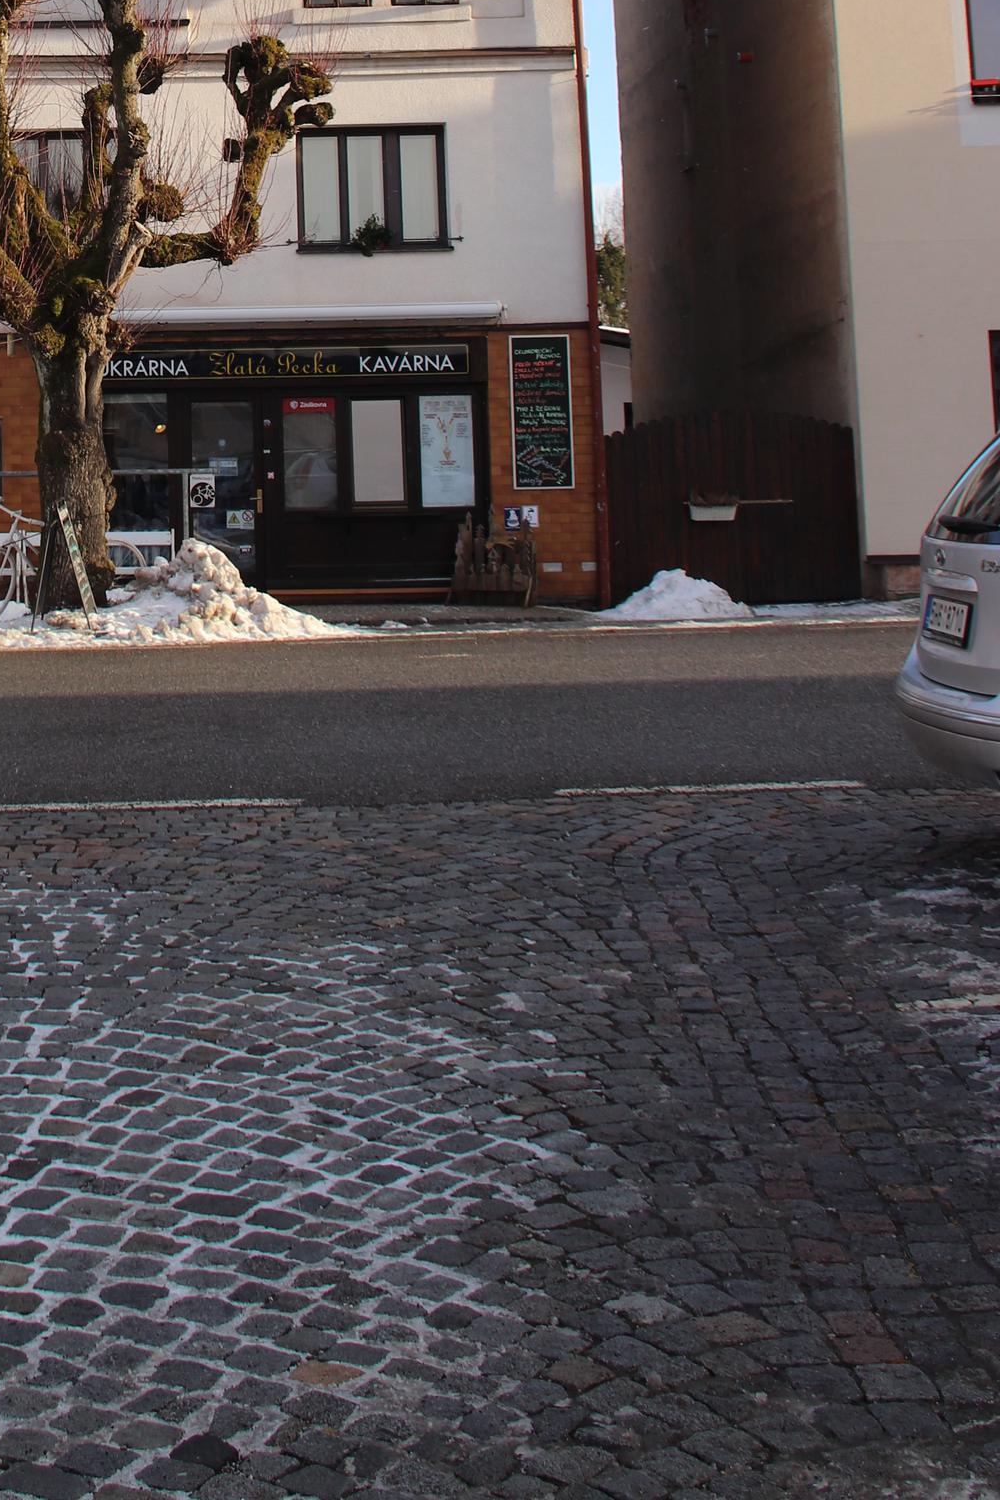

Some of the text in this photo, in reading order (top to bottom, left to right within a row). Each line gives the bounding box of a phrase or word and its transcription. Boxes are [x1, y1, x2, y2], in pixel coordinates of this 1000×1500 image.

[103, 356, 189, 377] UKRÁRNA
[209, 350, 337, 376] Zlatá Pecka
[359, 352, 455, 373] KAVÁRNA
